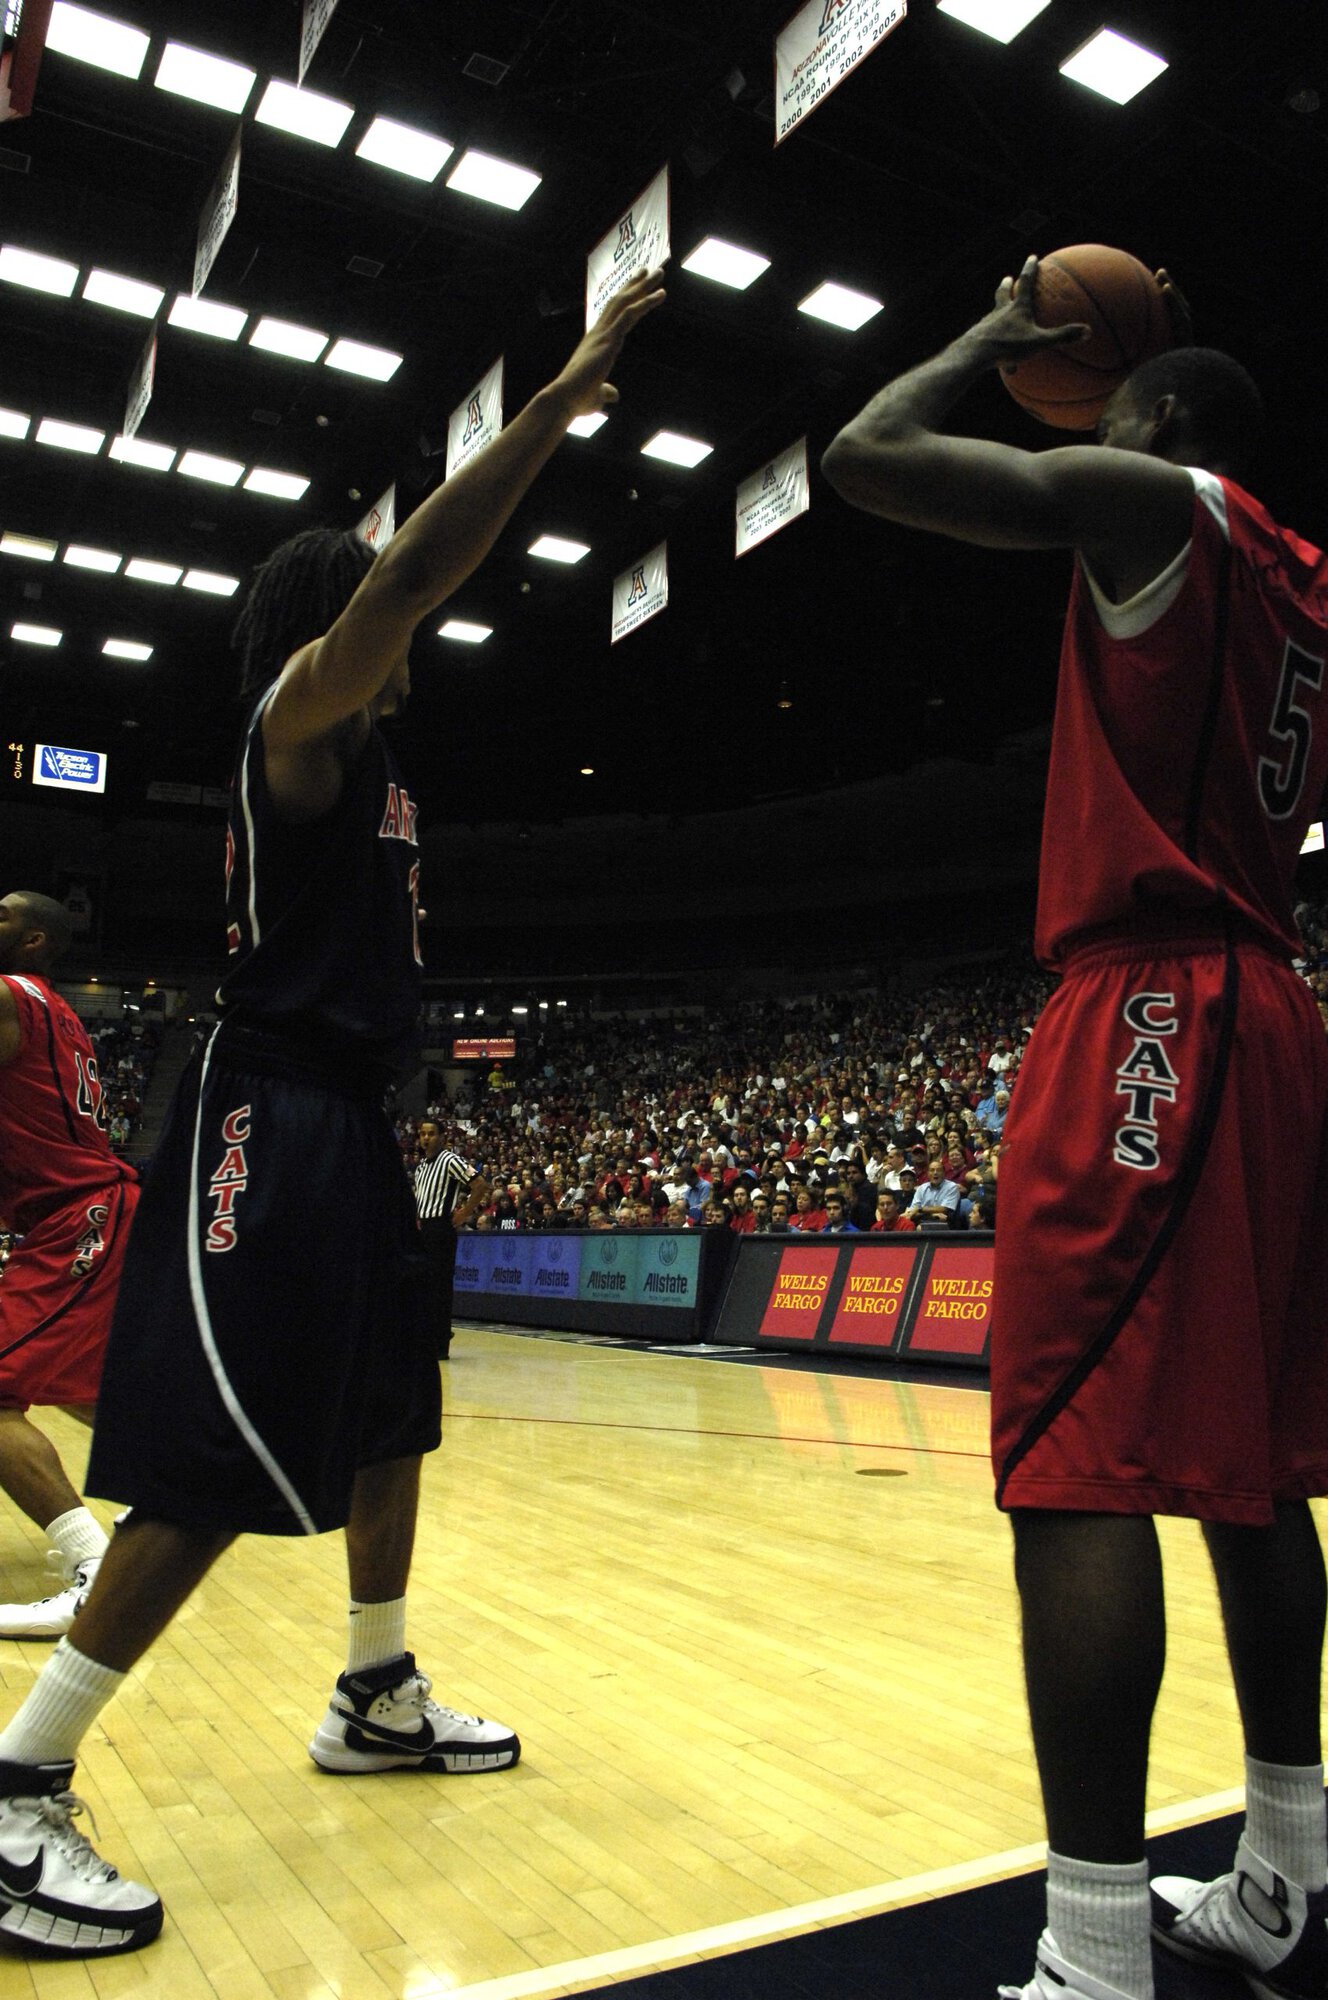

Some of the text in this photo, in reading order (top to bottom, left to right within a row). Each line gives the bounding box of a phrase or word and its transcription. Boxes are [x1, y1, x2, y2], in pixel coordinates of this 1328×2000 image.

[782, 74, 805, 105] NCAA
[806, 43, 838, 79] ROUND
[840, 27, 852, 45] OF
[796, 13, 880, 105] 1993 1994 1999
[781, 9, 896, 134] 2000 2001 2002 2005
[746, 510, 760, 522] NCAA
[1257, 634, 1325, 820] 5
[8, 742, 24, 752] 44
[1113, 992, 1180, 1170] CATS
[206, 1104, 251, 1253] CATS
[70, 1205, 109, 1278] CATS
[779, 1274, 828, 1291] WELLS
[850, 1277, 904, 1294] WELLS
[931, 1279, 994, 1298] WELLS
[773, 1293, 821, 1310] FARGO
[843, 1296, 897, 1314] FARGO
[924, 1300, 987, 1320] FARGO
